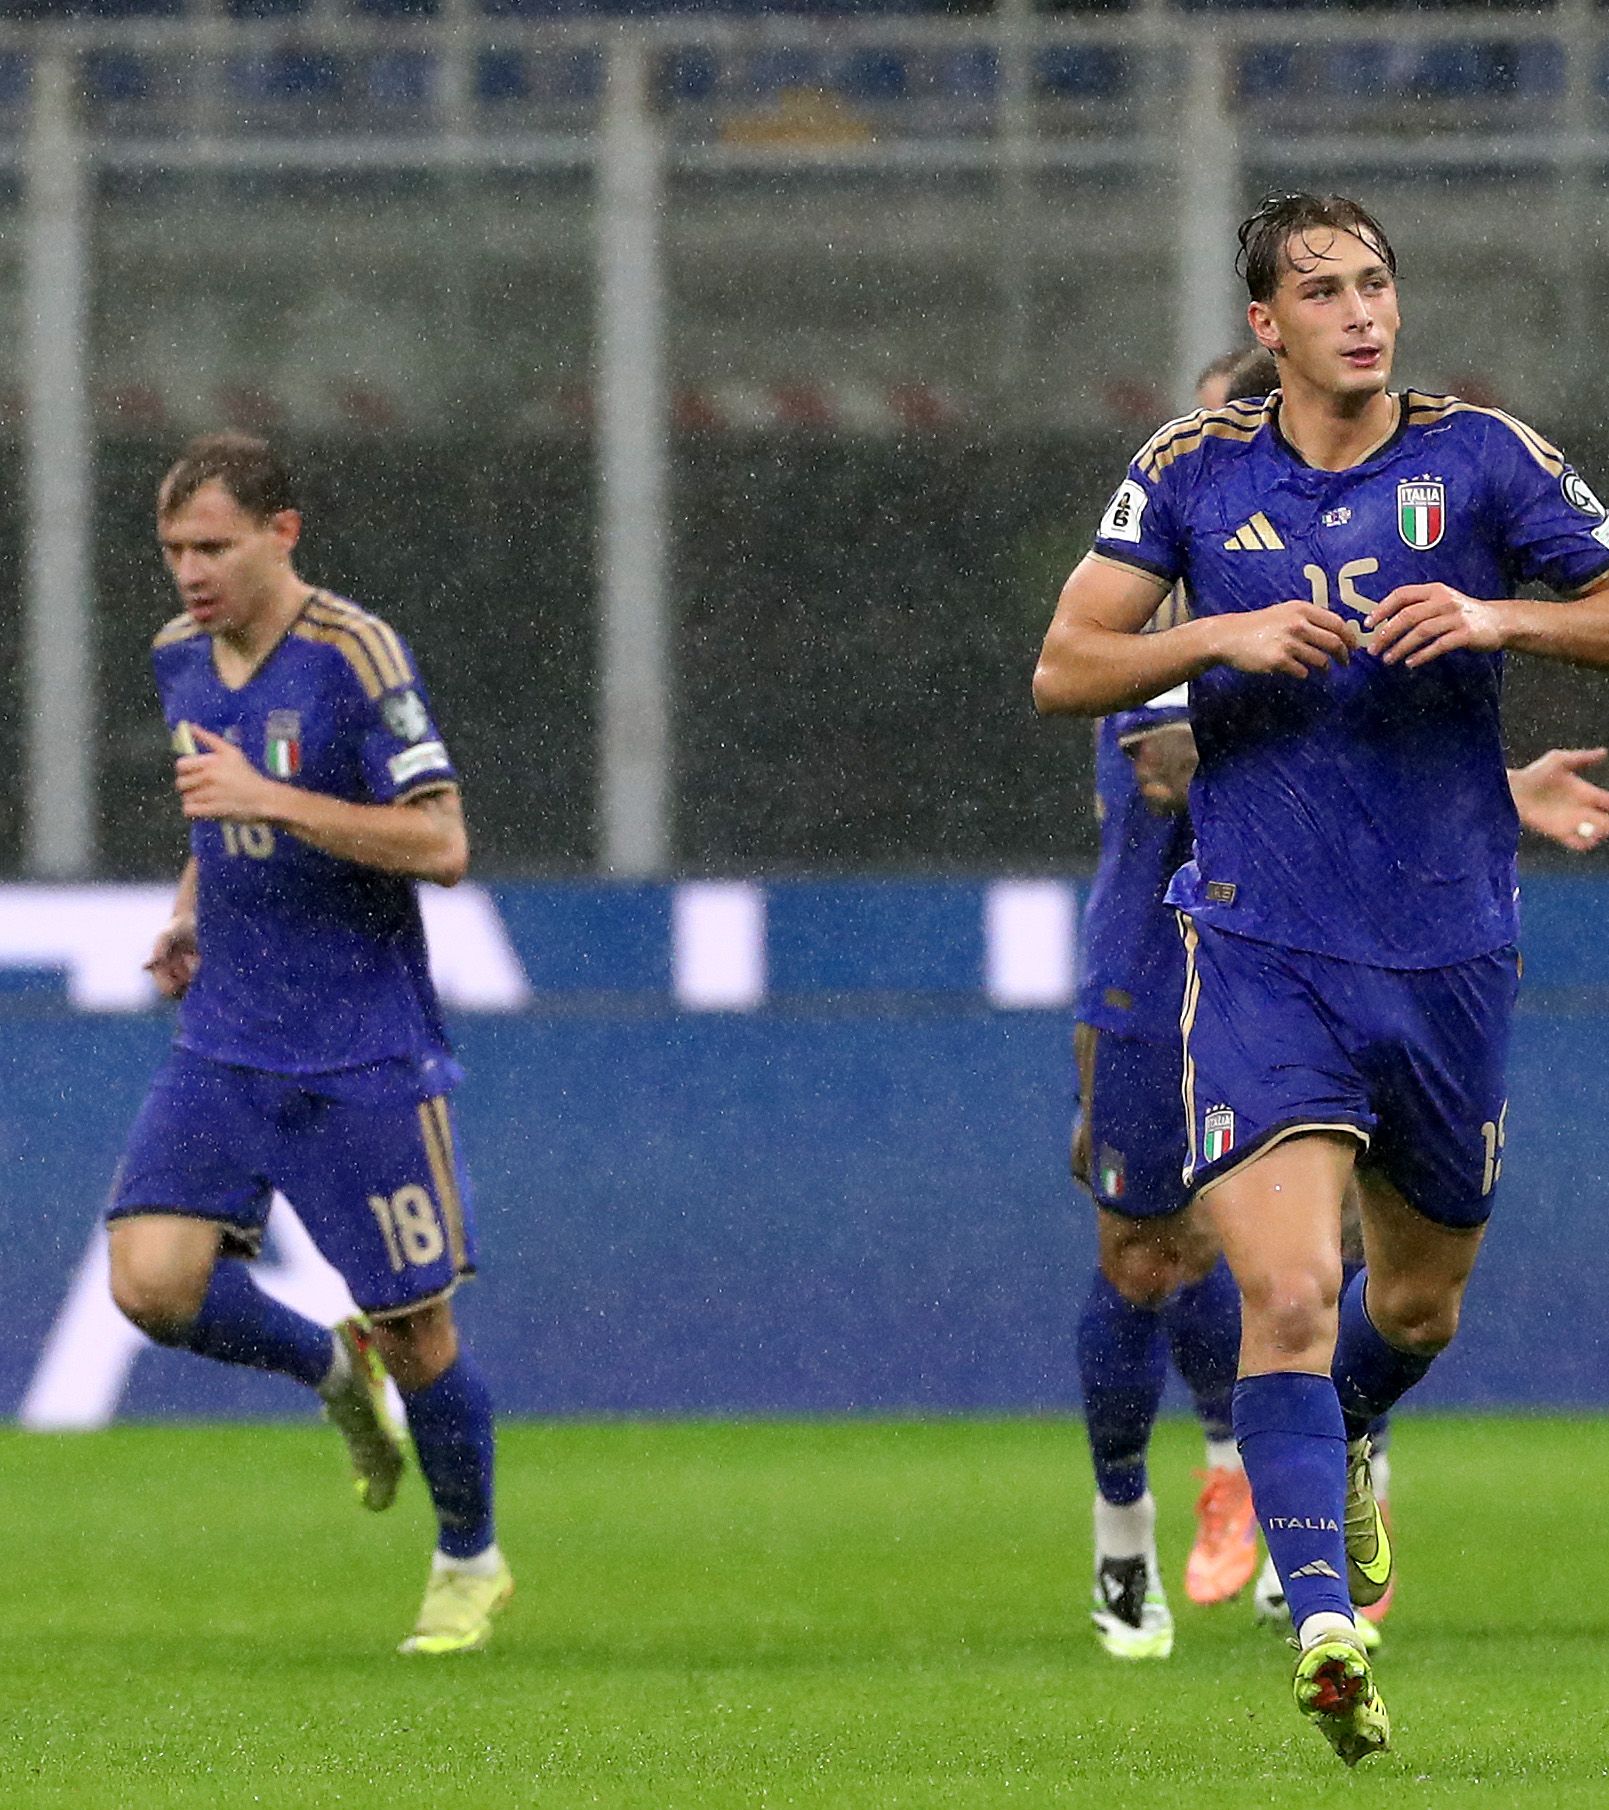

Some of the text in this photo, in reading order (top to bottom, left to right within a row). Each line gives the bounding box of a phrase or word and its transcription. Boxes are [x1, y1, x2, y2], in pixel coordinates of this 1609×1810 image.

[1401, 487, 1441, 502] ITALIA
[1481, 1098, 1508, 1196] 1
[367, 1183, 444, 1275] 18
[1268, 1516, 1340, 1533] ITALIA
